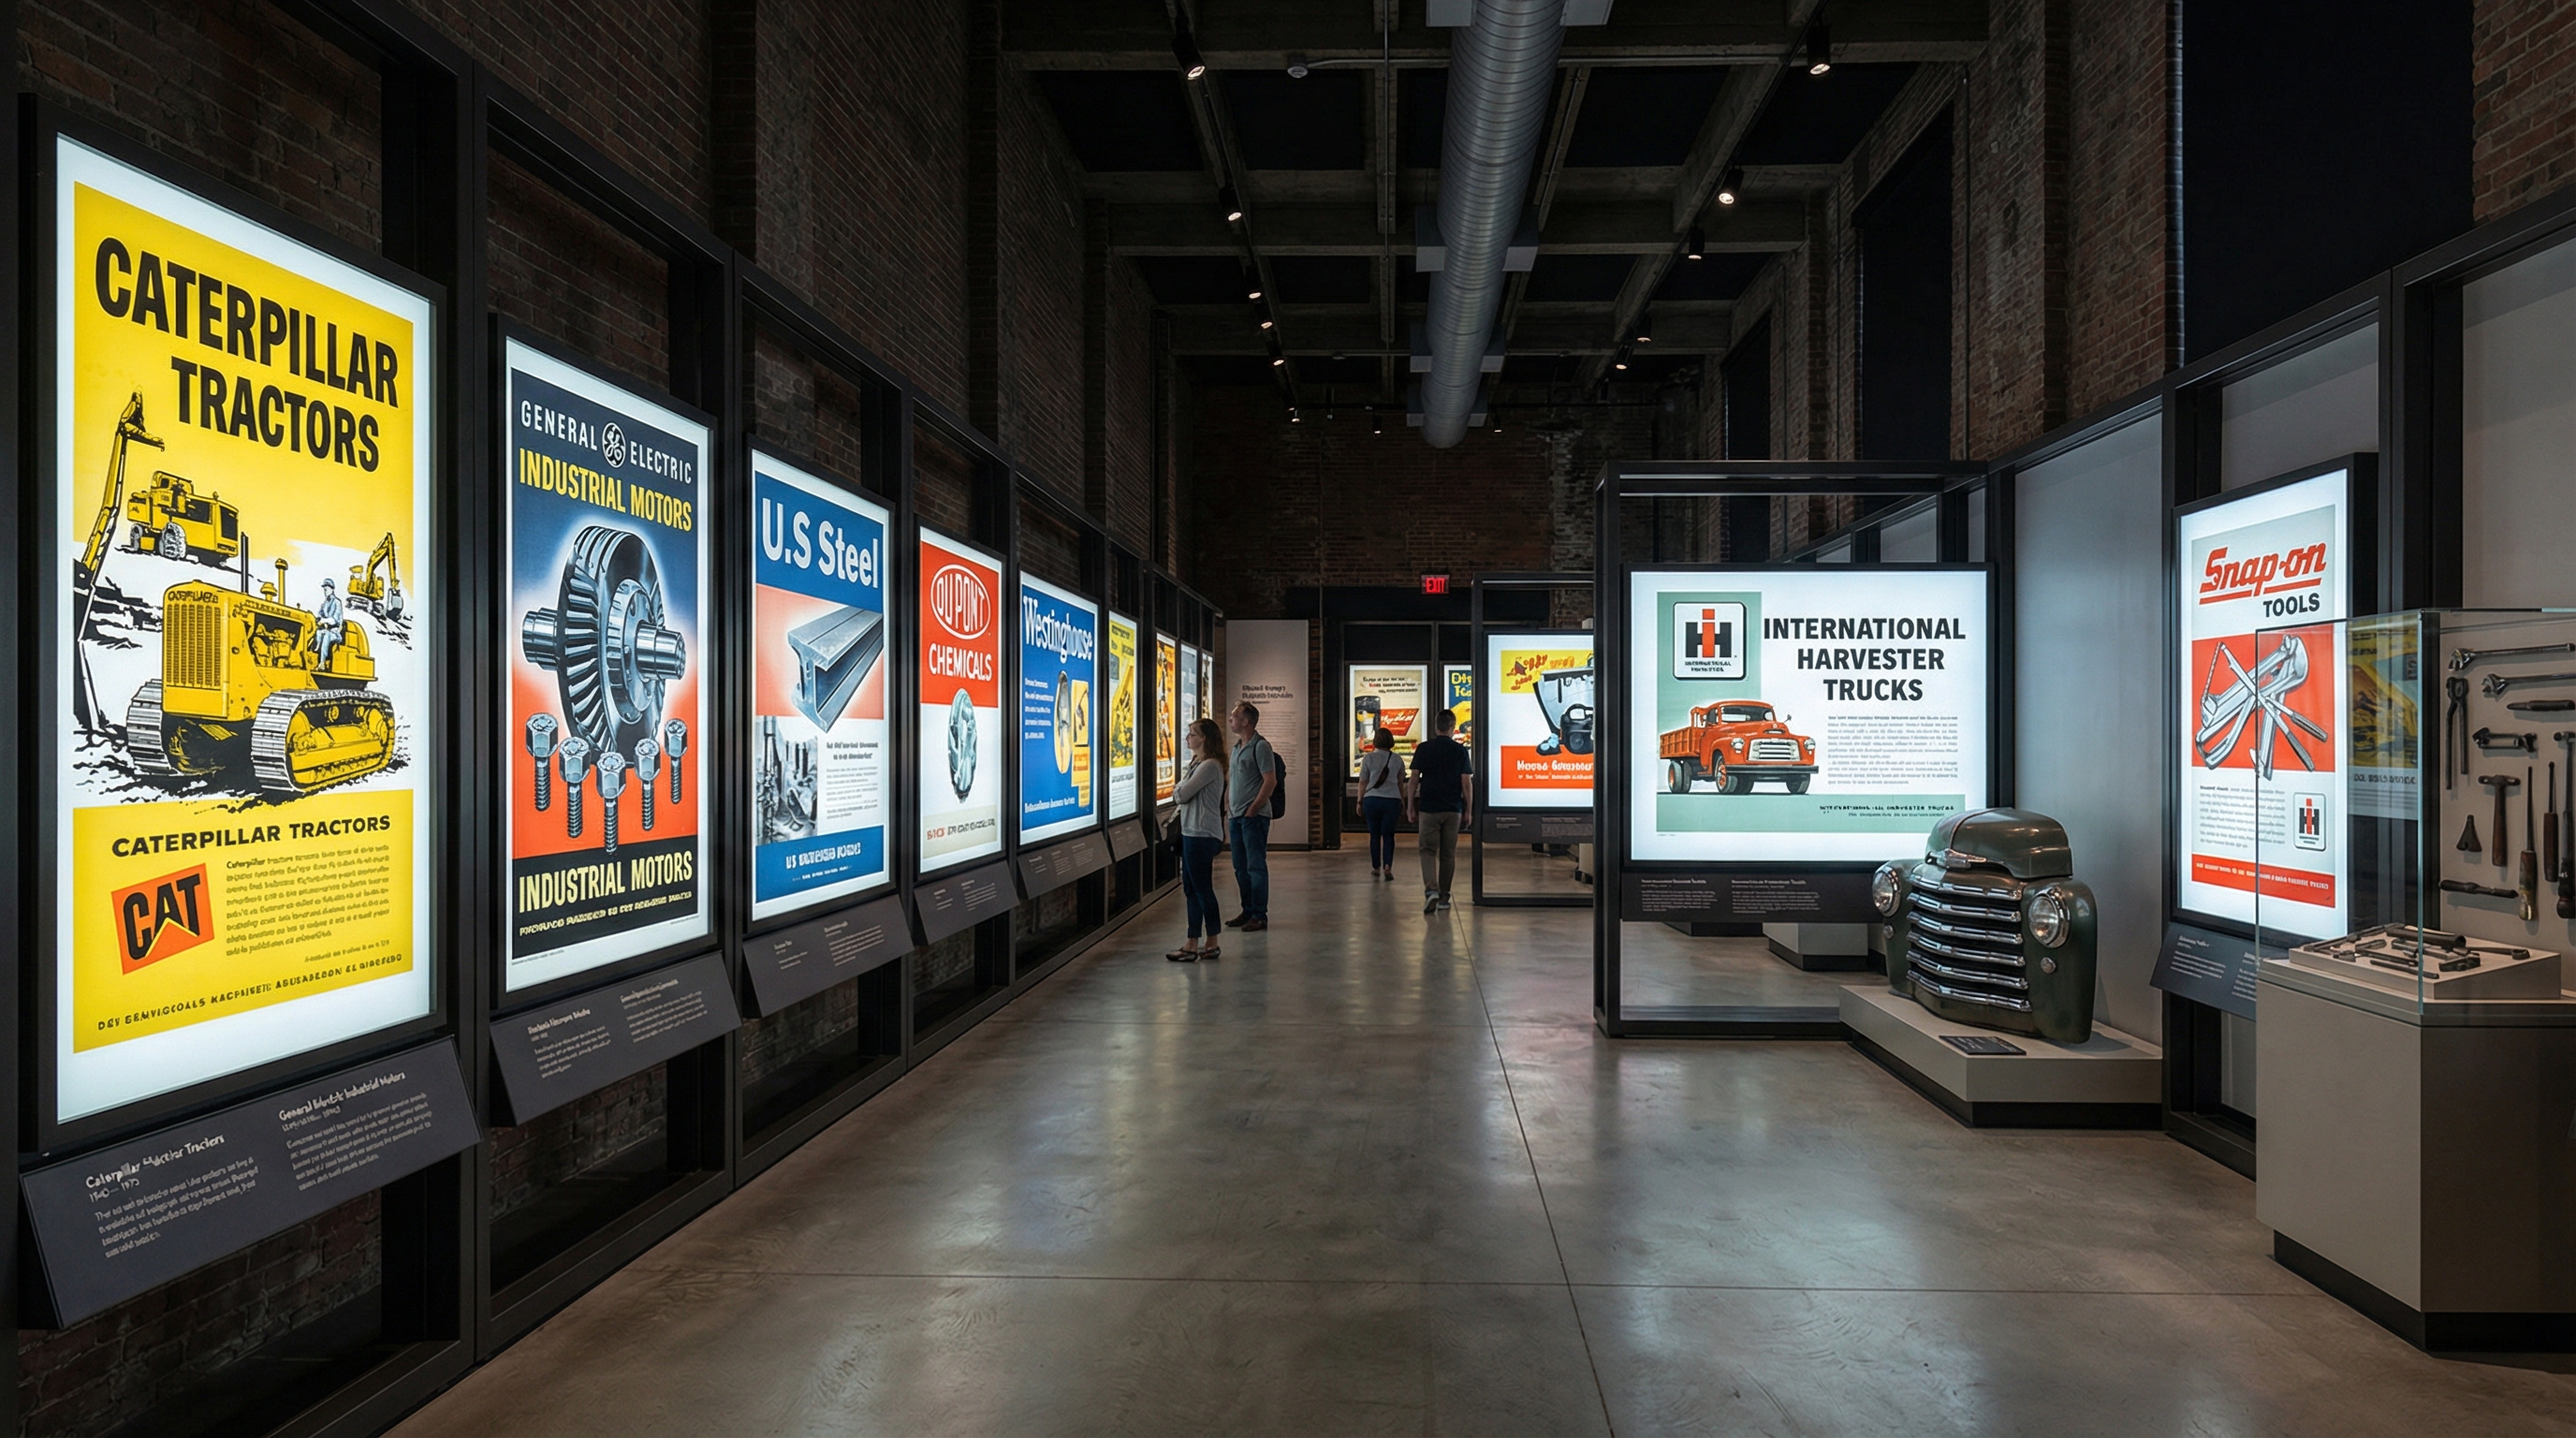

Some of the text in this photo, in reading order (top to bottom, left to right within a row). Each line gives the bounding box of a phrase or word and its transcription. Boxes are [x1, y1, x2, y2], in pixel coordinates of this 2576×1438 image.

[95, 237, 399, 408] CATERPILLAR
[171, 355, 379, 472] TRACTORS
[520, 400, 598, 451] GENERAL
[630, 441, 692, 484] ELECTRIC
[520, 448, 693, 532] INDUSTRIAL MOTORS
[762, 497, 879, 589] U.S Steel
[2199, 543, 2327, 597] Snap-on
[1023, 594, 1093, 664] Westinghouse
[1764, 618, 1966, 640] INTERNATIONAL
[2262, 593, 2320, 618] TOOLS
[929, 642, 992, 682] CHEMICALS
[1798, 649, 1945, 670] HARVESTER
[1823, 679, 1924, 701] TRUCKS
[111, 815, 391, 858] CATERPILLAR TRACTORS
[519, 851, 693, 913] INDUSTRIAL MOTORS
[123, 873, 201, 961] CAT
